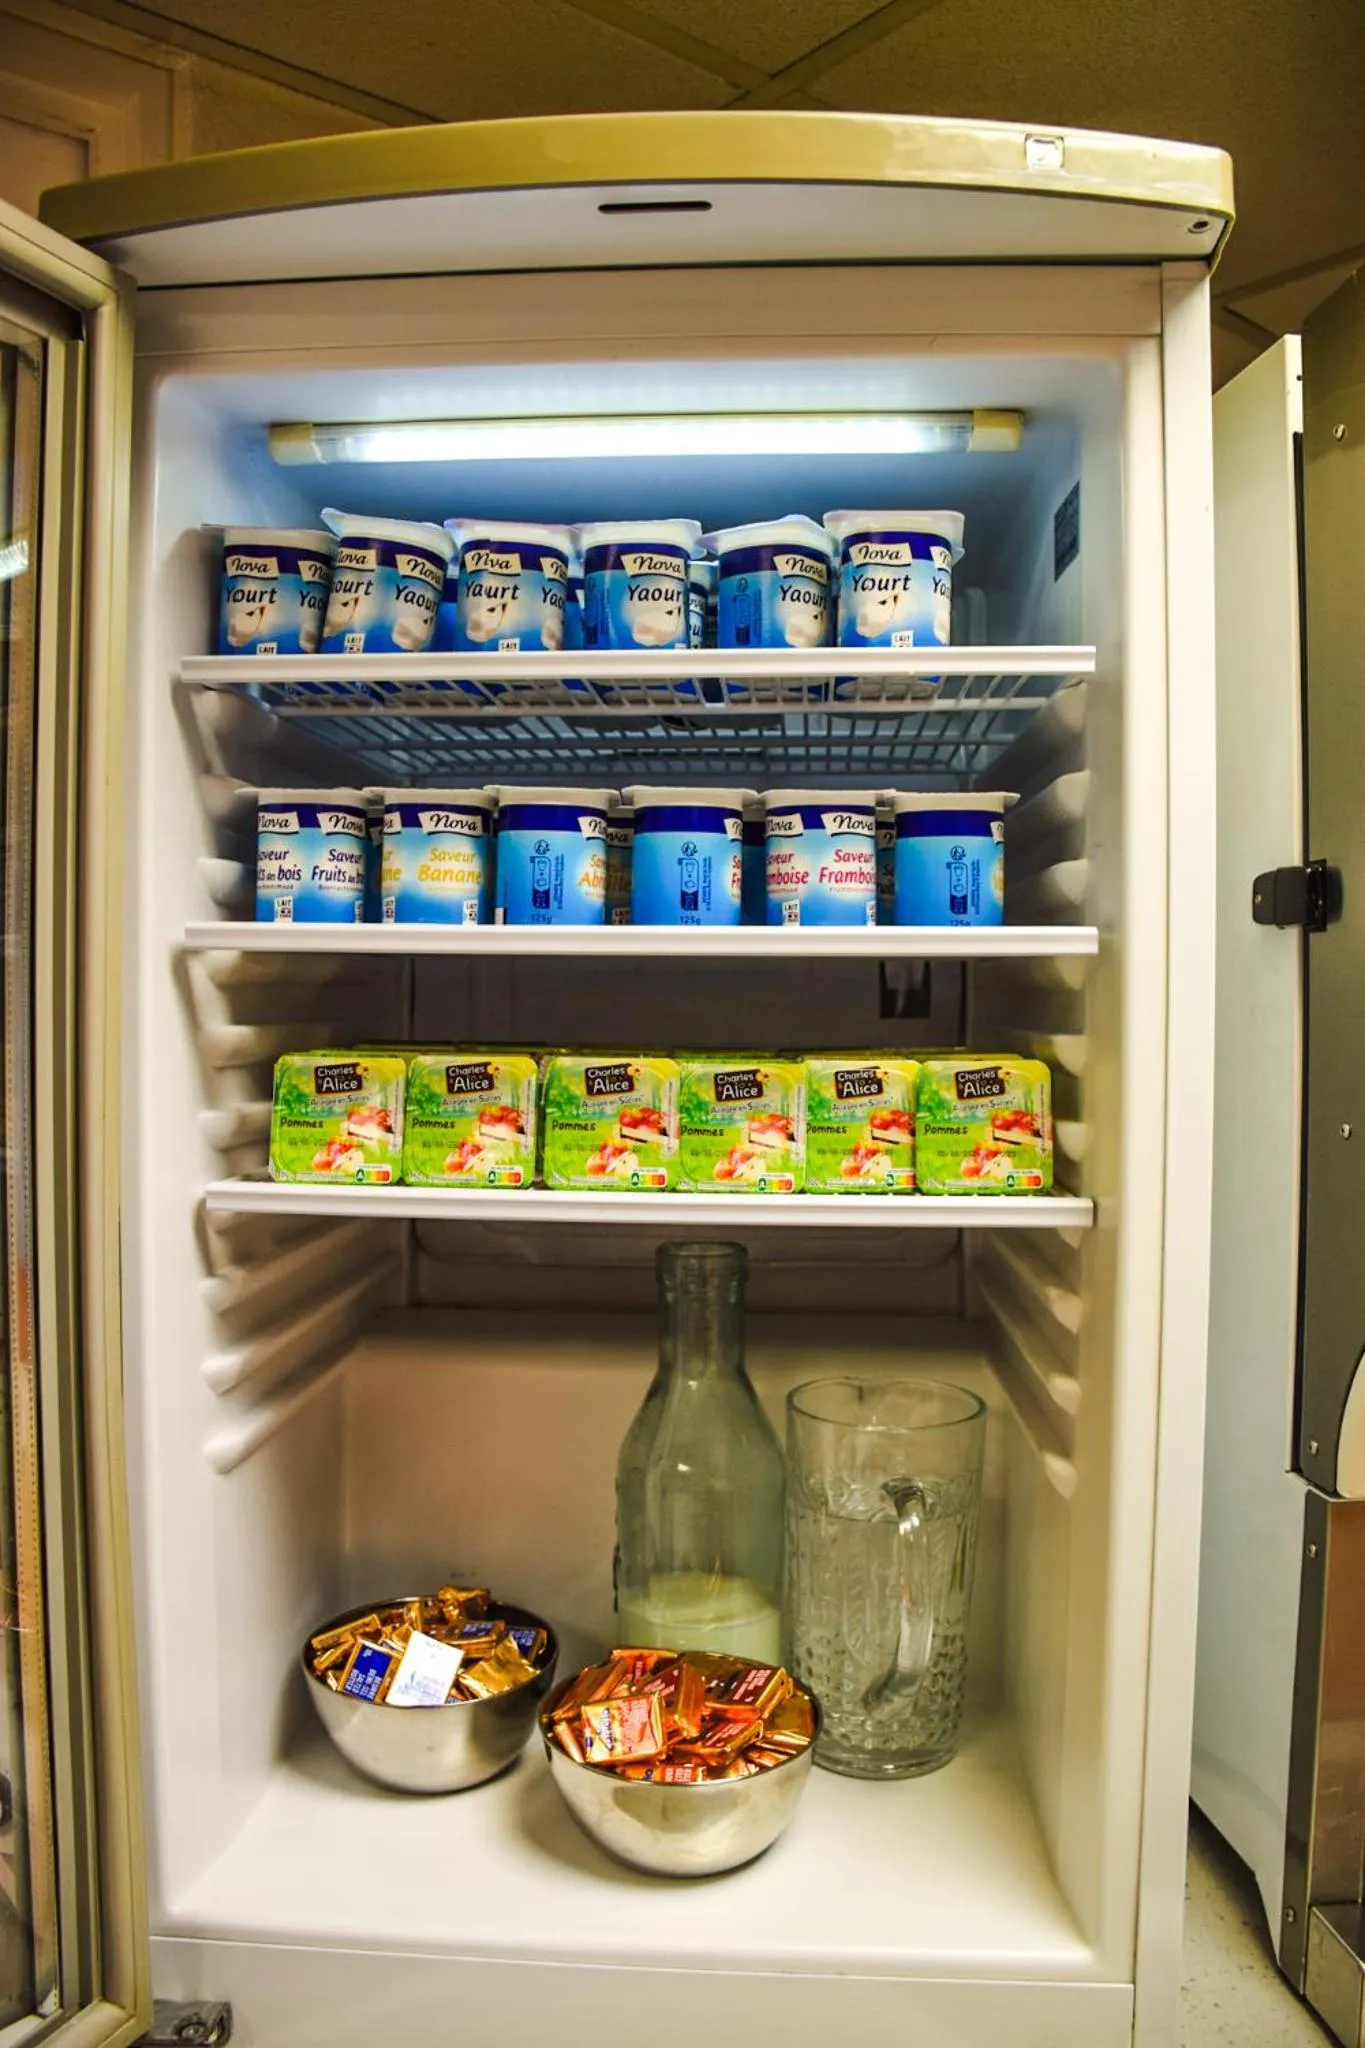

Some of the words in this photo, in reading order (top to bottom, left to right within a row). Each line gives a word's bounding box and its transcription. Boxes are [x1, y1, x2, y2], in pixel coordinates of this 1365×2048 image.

[632, 556, 682, 574] Nova
[628, 583, 682, 602] Yaour
[429, 813, 479, 832] Nova
[429, 847, 477, 863] Saveur
[277, 863, 303, 882] bois
[311, 864, 347, 883] Fruits
[316, 1065, 355, 1078] Charles
[448, 1065, 486, 1077] Charles
[586, 1066, 626, 1079] Charles
[716, 1072, 754, 1084] Charles
[837, 1070, 875, 1082] Charles
[957, 1070, 996, 1082] Charles
[321, 1077, 359, 1092] Alice
[453, 1077, 490, 1093] Alice
[593, 1078, 630, 1094] Alice
[842, 1081, 879, 1098] Alice
[963, 1081, 1000, 1098] Alice
[722, 1084, 759, 1100] Alice
[280, 1116, 325, 1129] Pommes
[412, 1117, 455, 1129] Pommes
[552, 1119, 597, 1132] Pommes
[806, 1122, 848, 1135] Pommes
[923, 1123, 968, 1136] Pommes
[680, 1124, 725, 1137] Pommes
